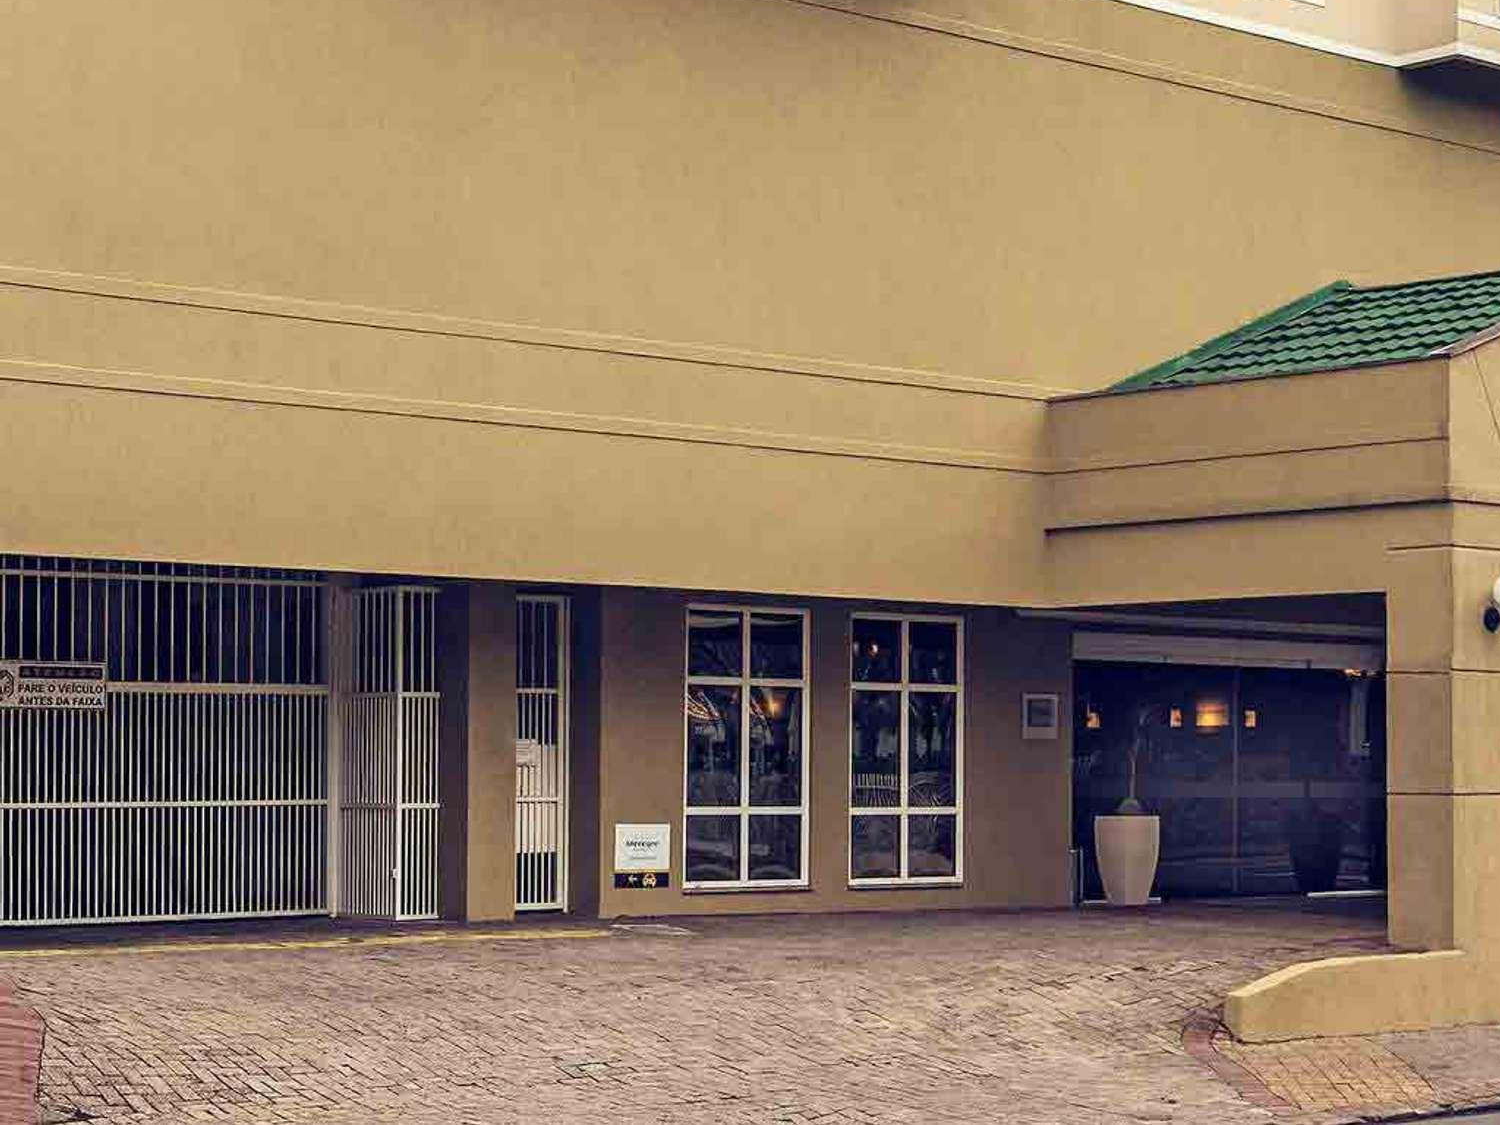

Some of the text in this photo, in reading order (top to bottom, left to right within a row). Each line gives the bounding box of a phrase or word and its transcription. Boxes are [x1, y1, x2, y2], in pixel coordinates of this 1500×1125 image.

[18, 683, 45, 693] PARE
[48, 683, 56, 693] O
[19, 696, 103, 705] ANTES DA FAIXA
